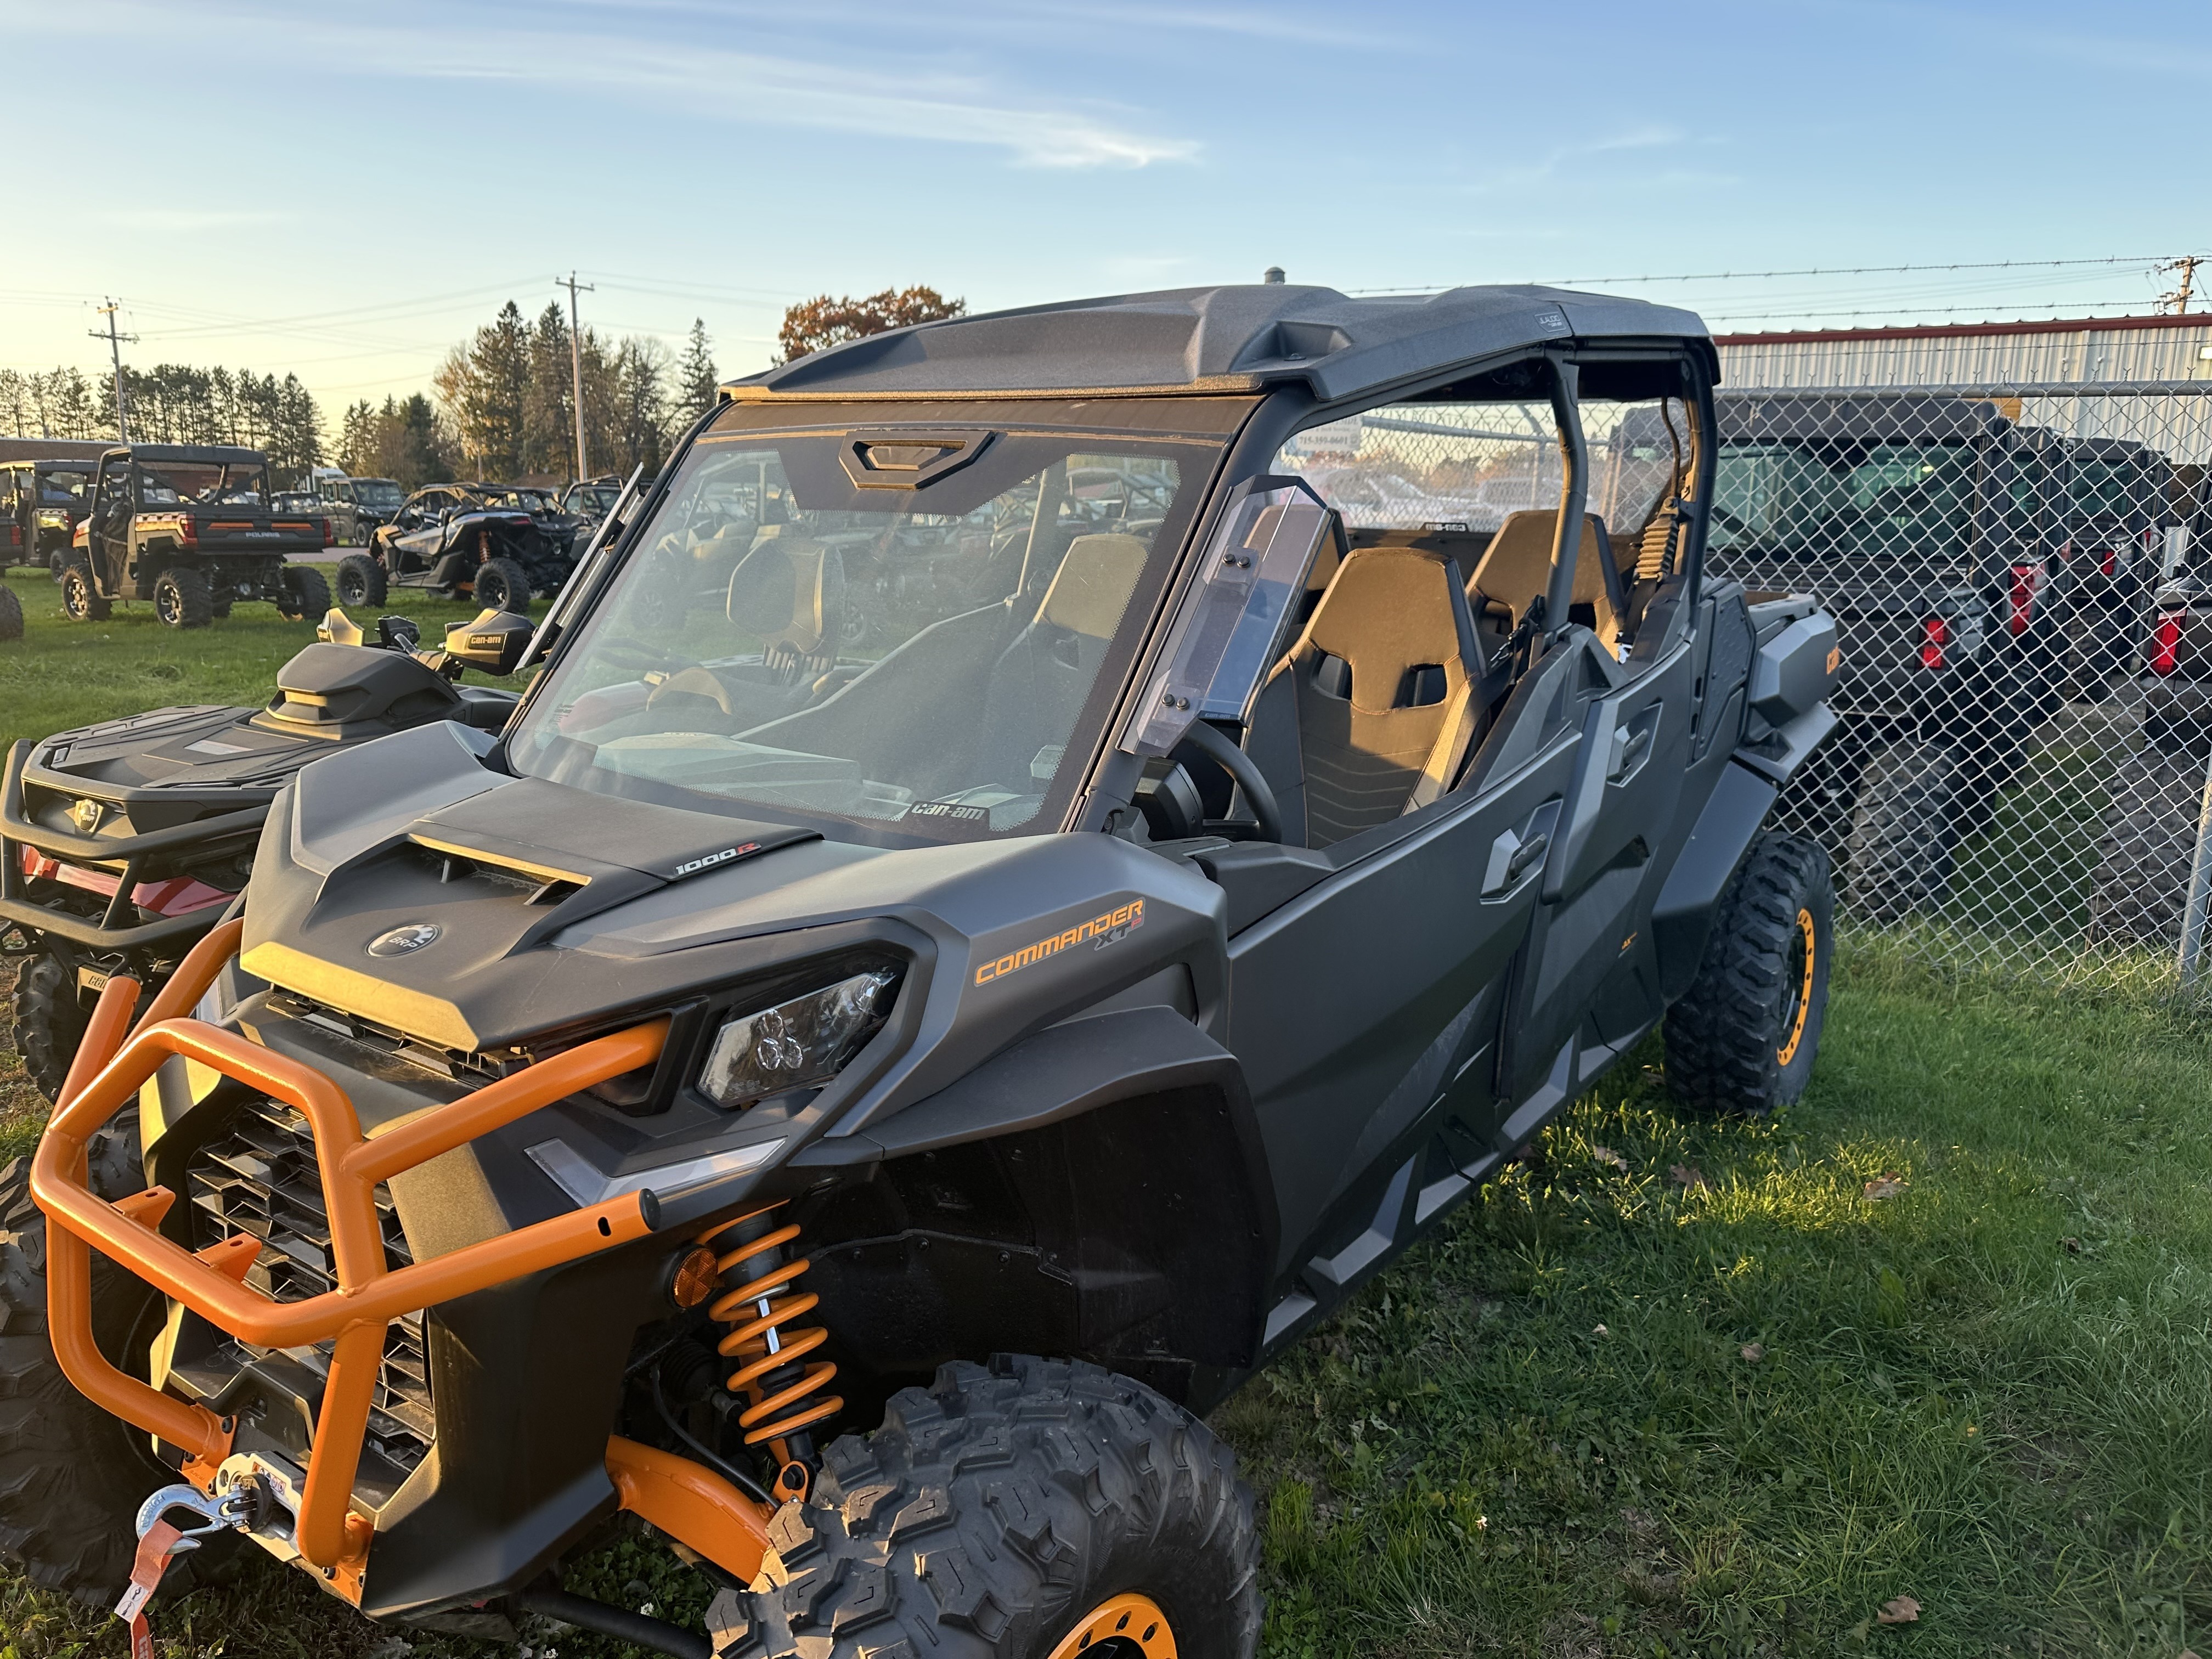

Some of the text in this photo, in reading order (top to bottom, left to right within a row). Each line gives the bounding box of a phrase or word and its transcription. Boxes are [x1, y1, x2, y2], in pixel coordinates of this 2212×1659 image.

[911, 803, 985, 820] can-am
[675, 843, 757, 875] 1000R
[388, 936, 418, 947] BRP
[975, 900, 1143, 984] COMMANDER
